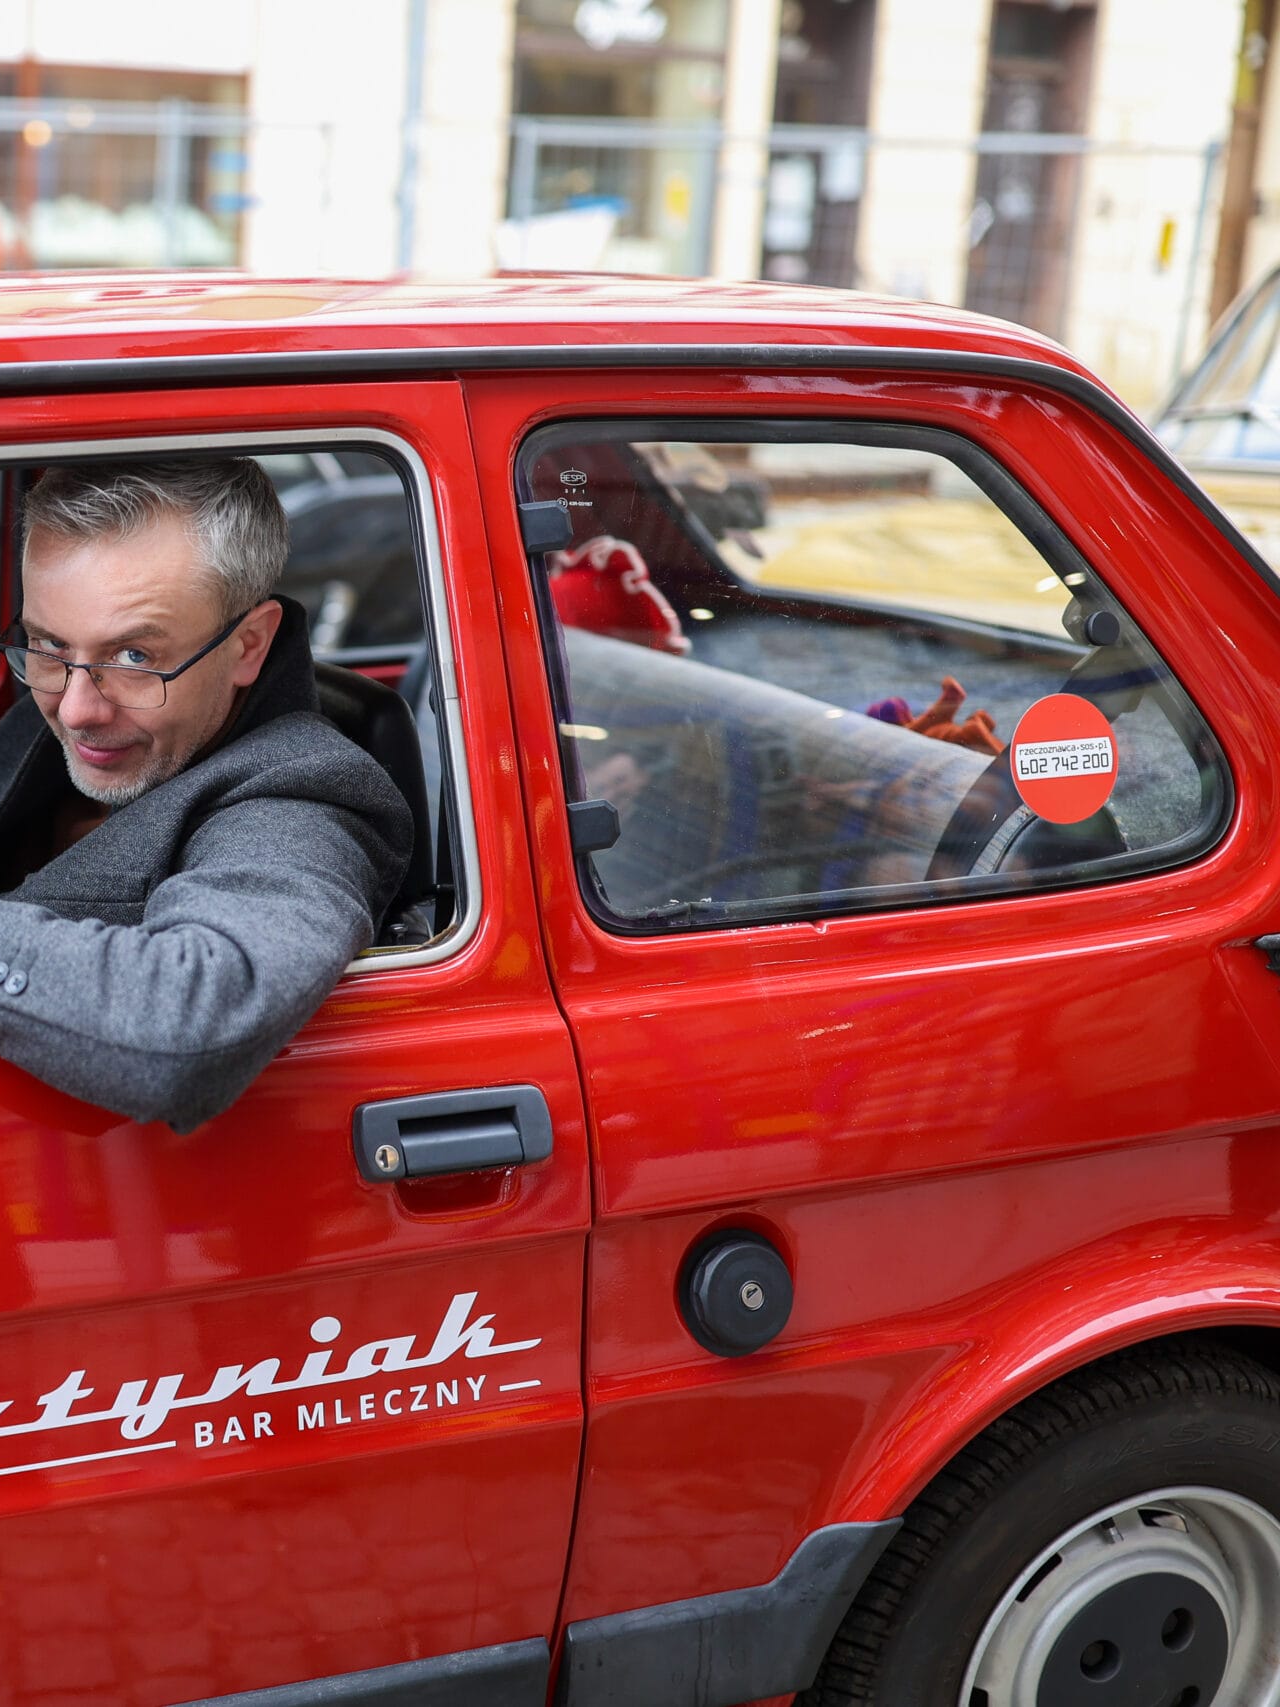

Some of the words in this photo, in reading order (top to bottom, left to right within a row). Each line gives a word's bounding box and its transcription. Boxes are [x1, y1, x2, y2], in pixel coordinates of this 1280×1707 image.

[1020, 758, 1048, 775] 602
[1051, 755, 1079, 772] 742
[1082, 752, 1109, 770] 200
[194, 1411, 274, 1449] BAR
[297, 1374, 487, 1432] MLECZNY
